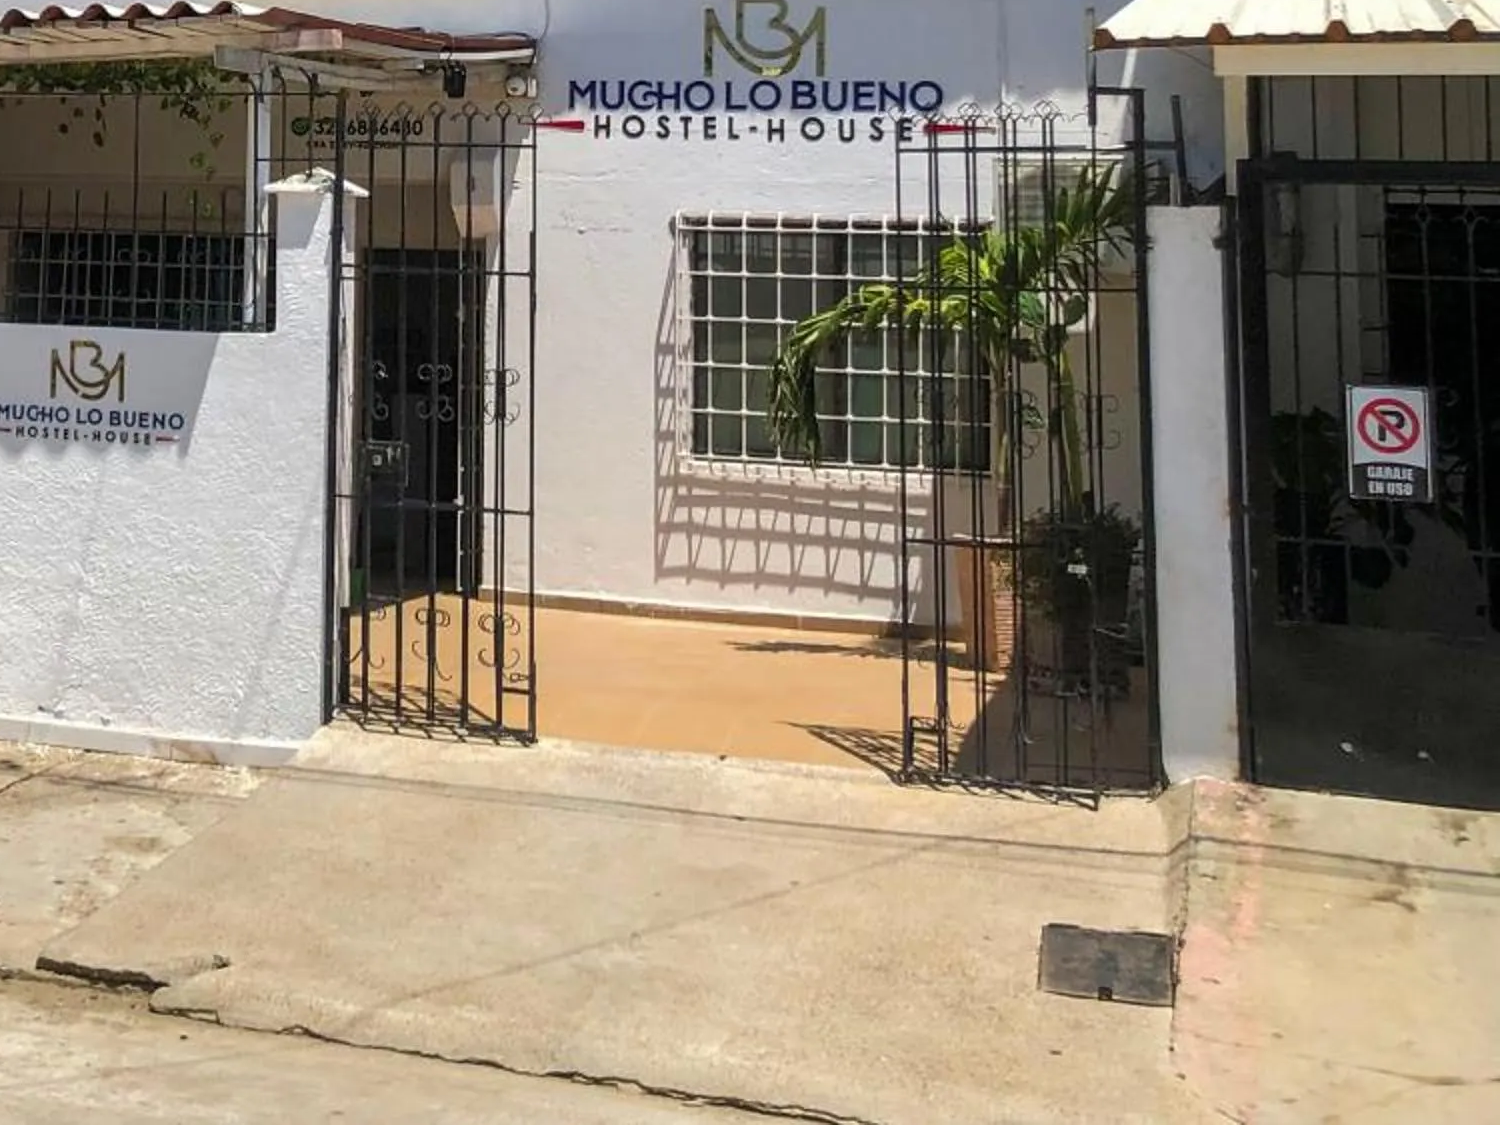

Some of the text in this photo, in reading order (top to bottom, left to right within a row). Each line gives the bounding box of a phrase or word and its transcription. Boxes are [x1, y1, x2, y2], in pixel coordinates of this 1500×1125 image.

[568, 80, 943, 113] MUCHO LO BUENO
[76, 408, 102, 425] LO
[110, 410, 185, 430] BUENO
[1387, 482, 1413, 495] USO
